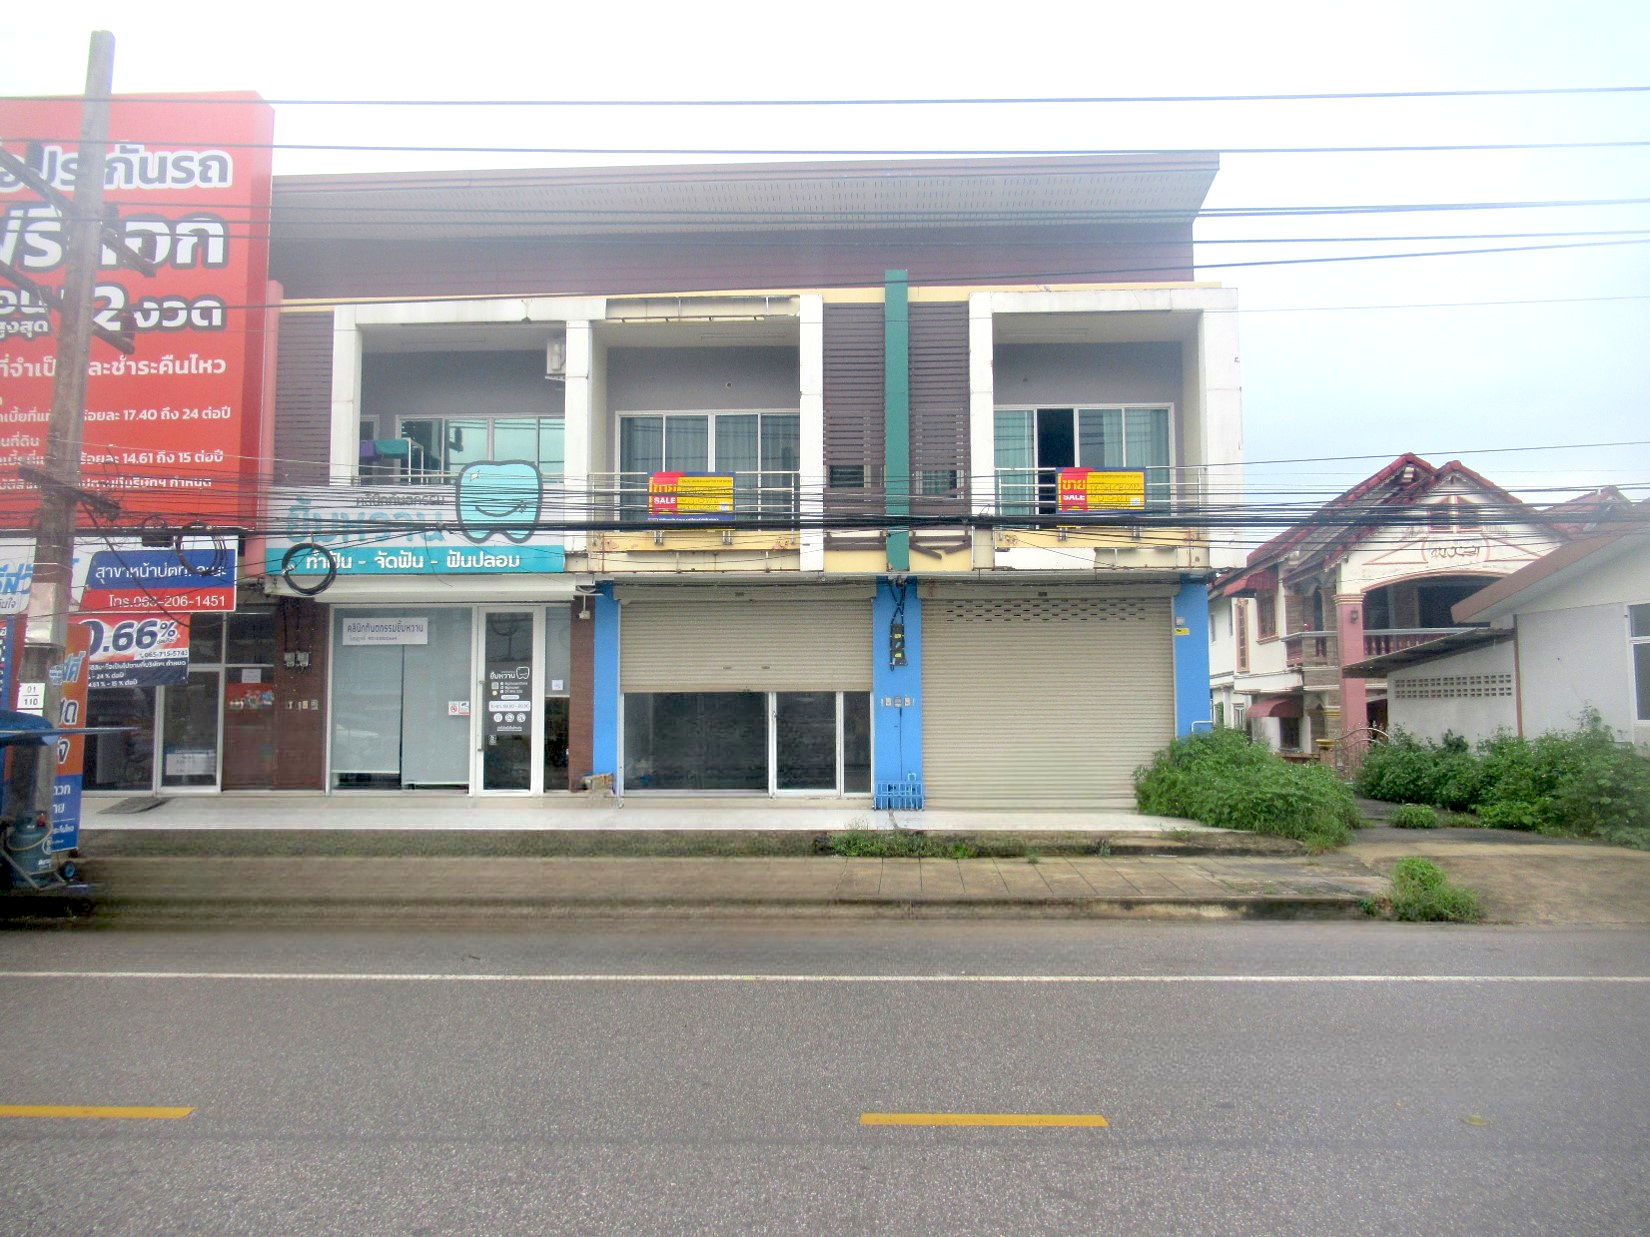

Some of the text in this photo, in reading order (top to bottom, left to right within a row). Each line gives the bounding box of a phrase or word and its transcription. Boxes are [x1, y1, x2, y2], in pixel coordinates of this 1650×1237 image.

[134, 300, 222, 327] งวด
[123, 409, 158, 421] 17.40
[182, 408, 199, 420] 24
[202, 406, 231, 420] ต่อปี
[122, 452, 153, 464] 14.61
[179, 452, 191, 463] 15
[374, 551, 424, 569] จัดฟัน
[447, 550, 520, 569] ฟันปลอม
